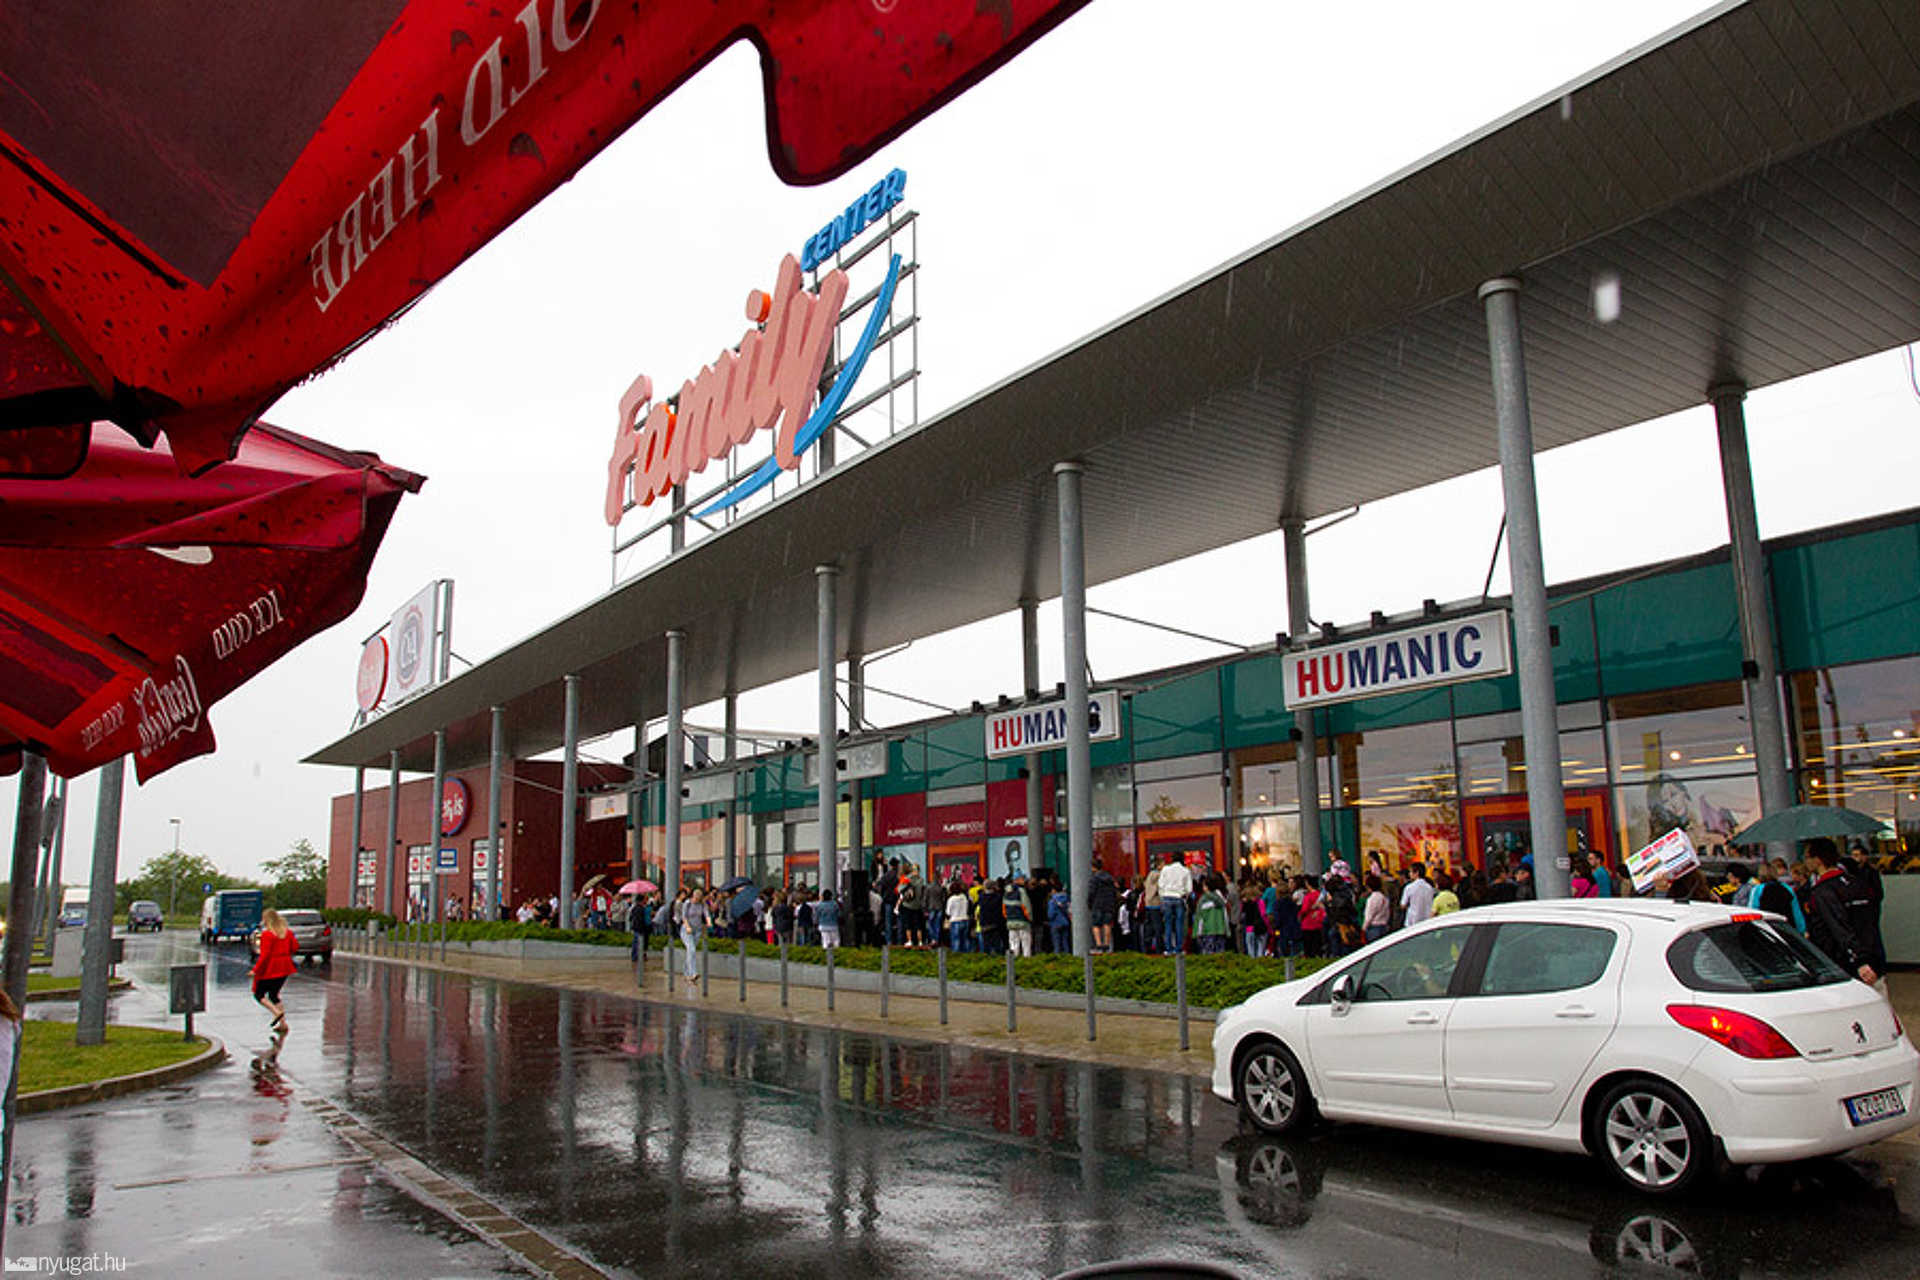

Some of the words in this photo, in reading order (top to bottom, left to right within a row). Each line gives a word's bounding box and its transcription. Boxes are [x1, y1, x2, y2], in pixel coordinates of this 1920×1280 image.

[801, 168, 907, 273] CENTER
[605, 252, 849, 526] Family
[1297, 624, 1483, 698] HUMANIC
